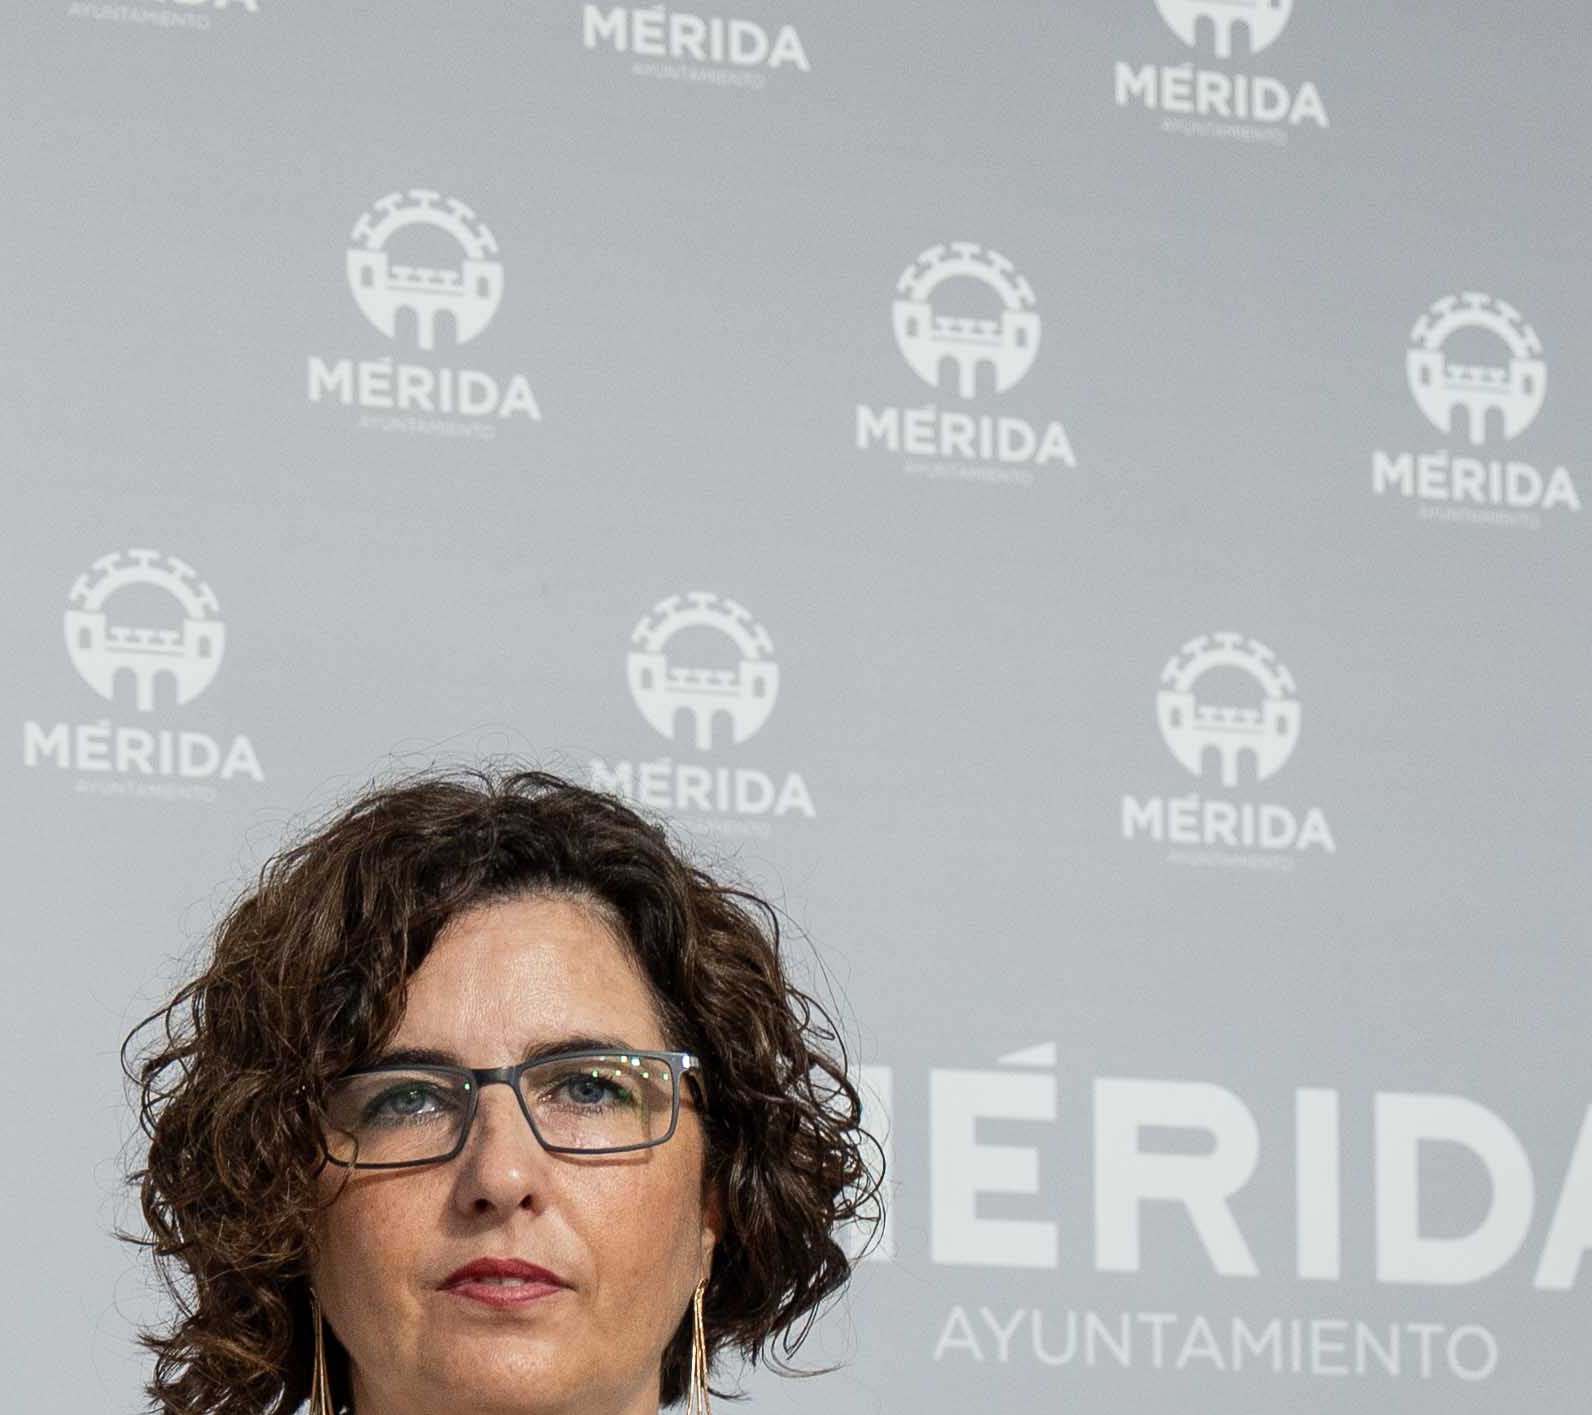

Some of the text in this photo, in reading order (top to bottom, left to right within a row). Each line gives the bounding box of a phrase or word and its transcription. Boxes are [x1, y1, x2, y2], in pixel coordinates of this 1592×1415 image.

[584, 5, 809, 70] MÉRIDA
[1116, 62, 1328, 127] MÉRIDA
[309, 358, 540, 420] MÉRIDA
[857, 405, 1075, 467] MÉRIDA
[1373, 451, 1580, 510] MÉRIDA
[25, 720, 264, 781] MÉRIDA
[590, 758, 816, 818] MÉRIDA
[1122, 795, 1334, 852] MÉRIDA
[933, 1304, 1499, 1382] AYUNTAMIENTO
